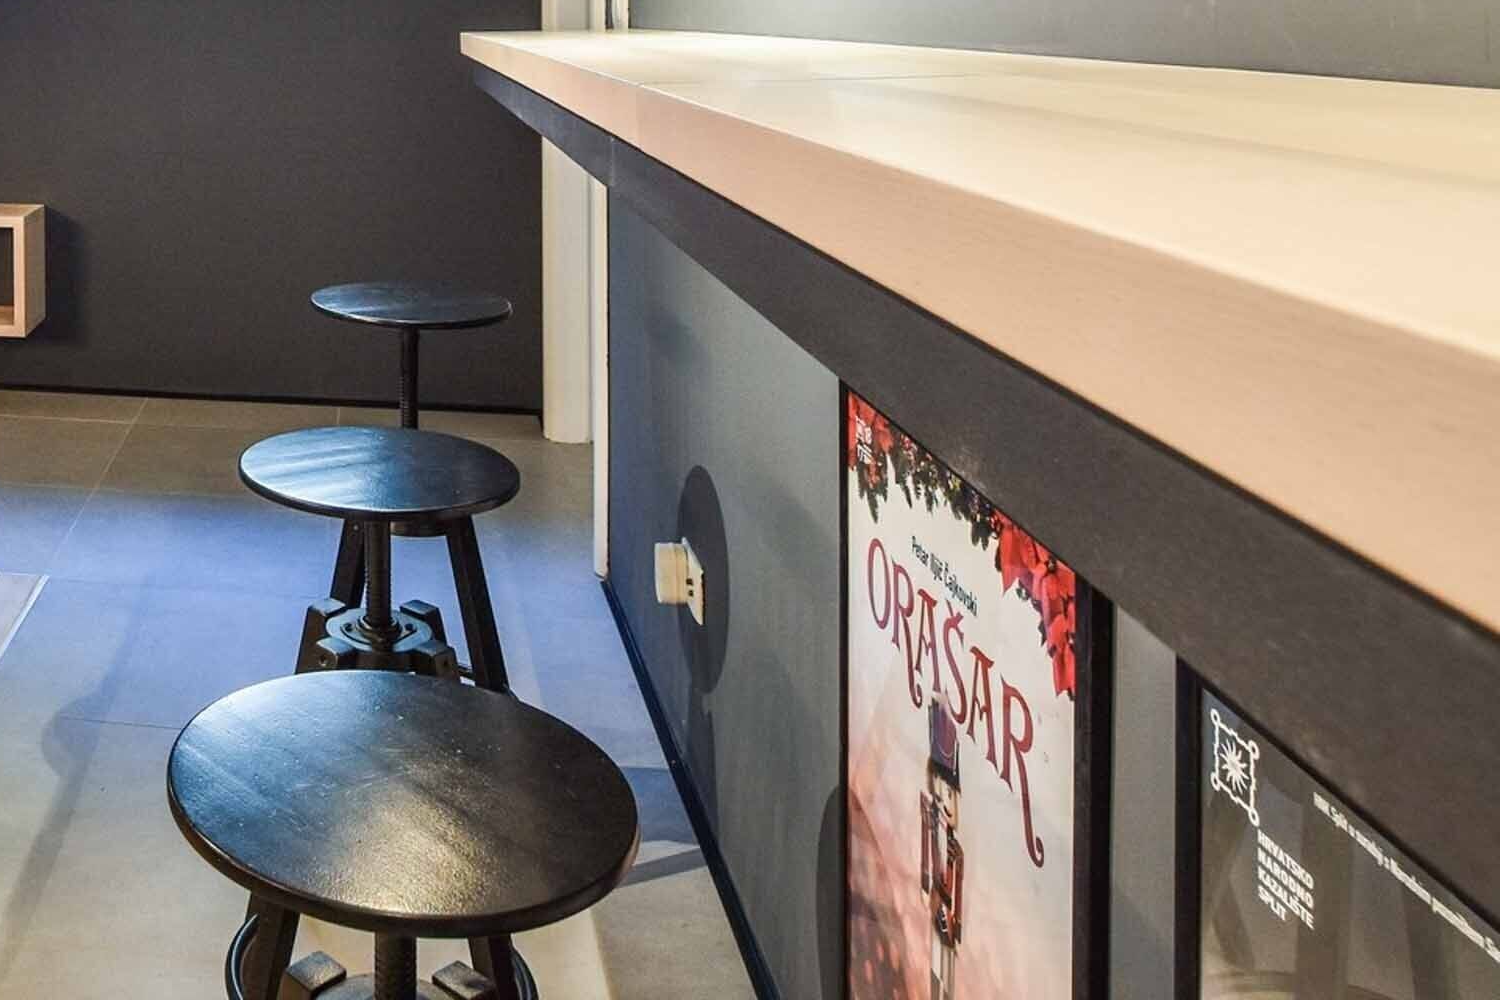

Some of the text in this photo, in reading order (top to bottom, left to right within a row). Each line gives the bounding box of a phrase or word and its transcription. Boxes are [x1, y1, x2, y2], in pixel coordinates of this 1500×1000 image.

[868, 538, 1045, 868] ORAŠAR
[1257, 829, 1314, 889] HRVATSKO
[1257, 847, 1314, 910] NARODNO
[1257, 866, 1315, 931] KAZALIŠTE
[1257, 885, 1287, 921] SPLIT
